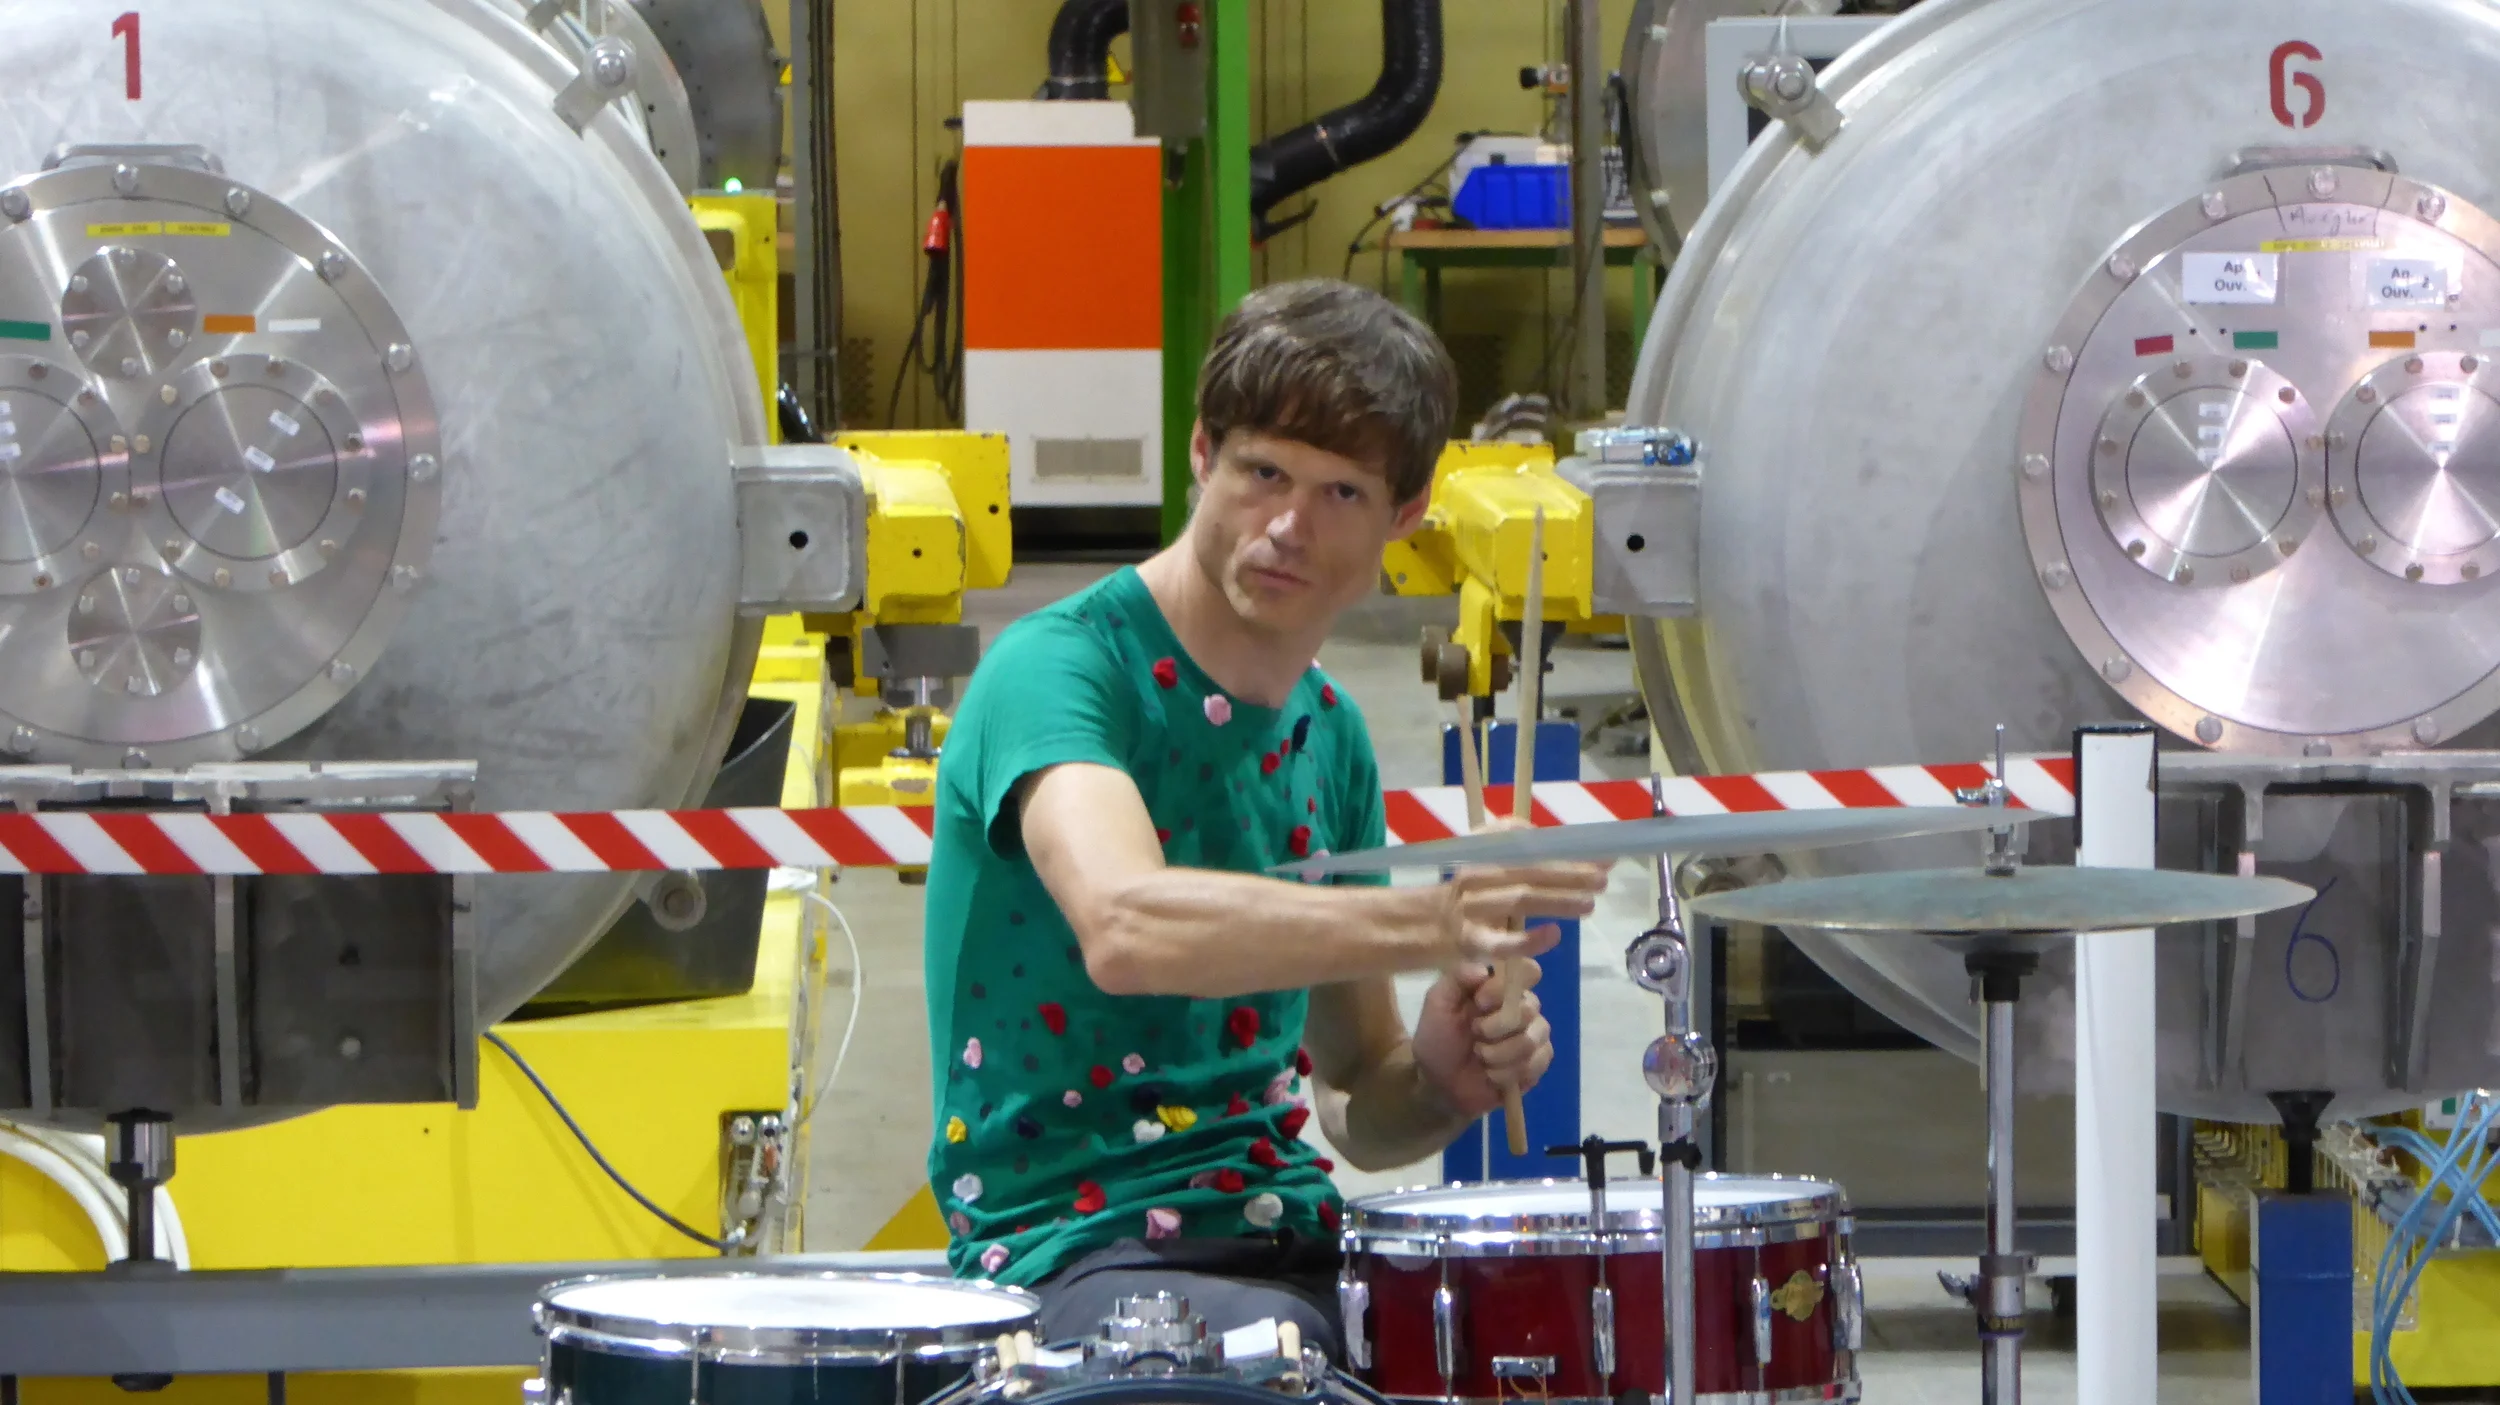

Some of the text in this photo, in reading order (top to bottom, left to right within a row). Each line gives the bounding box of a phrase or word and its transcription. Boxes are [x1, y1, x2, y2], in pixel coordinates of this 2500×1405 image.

[112, 12, 141, 100] 1
[2270, 40, 2325, 128] 6
[2214, 279, 2247, 292] Ouv.
[2381, 286, 2413, 298] Ouv.
[2285, 876, 2340, 1003] 6
